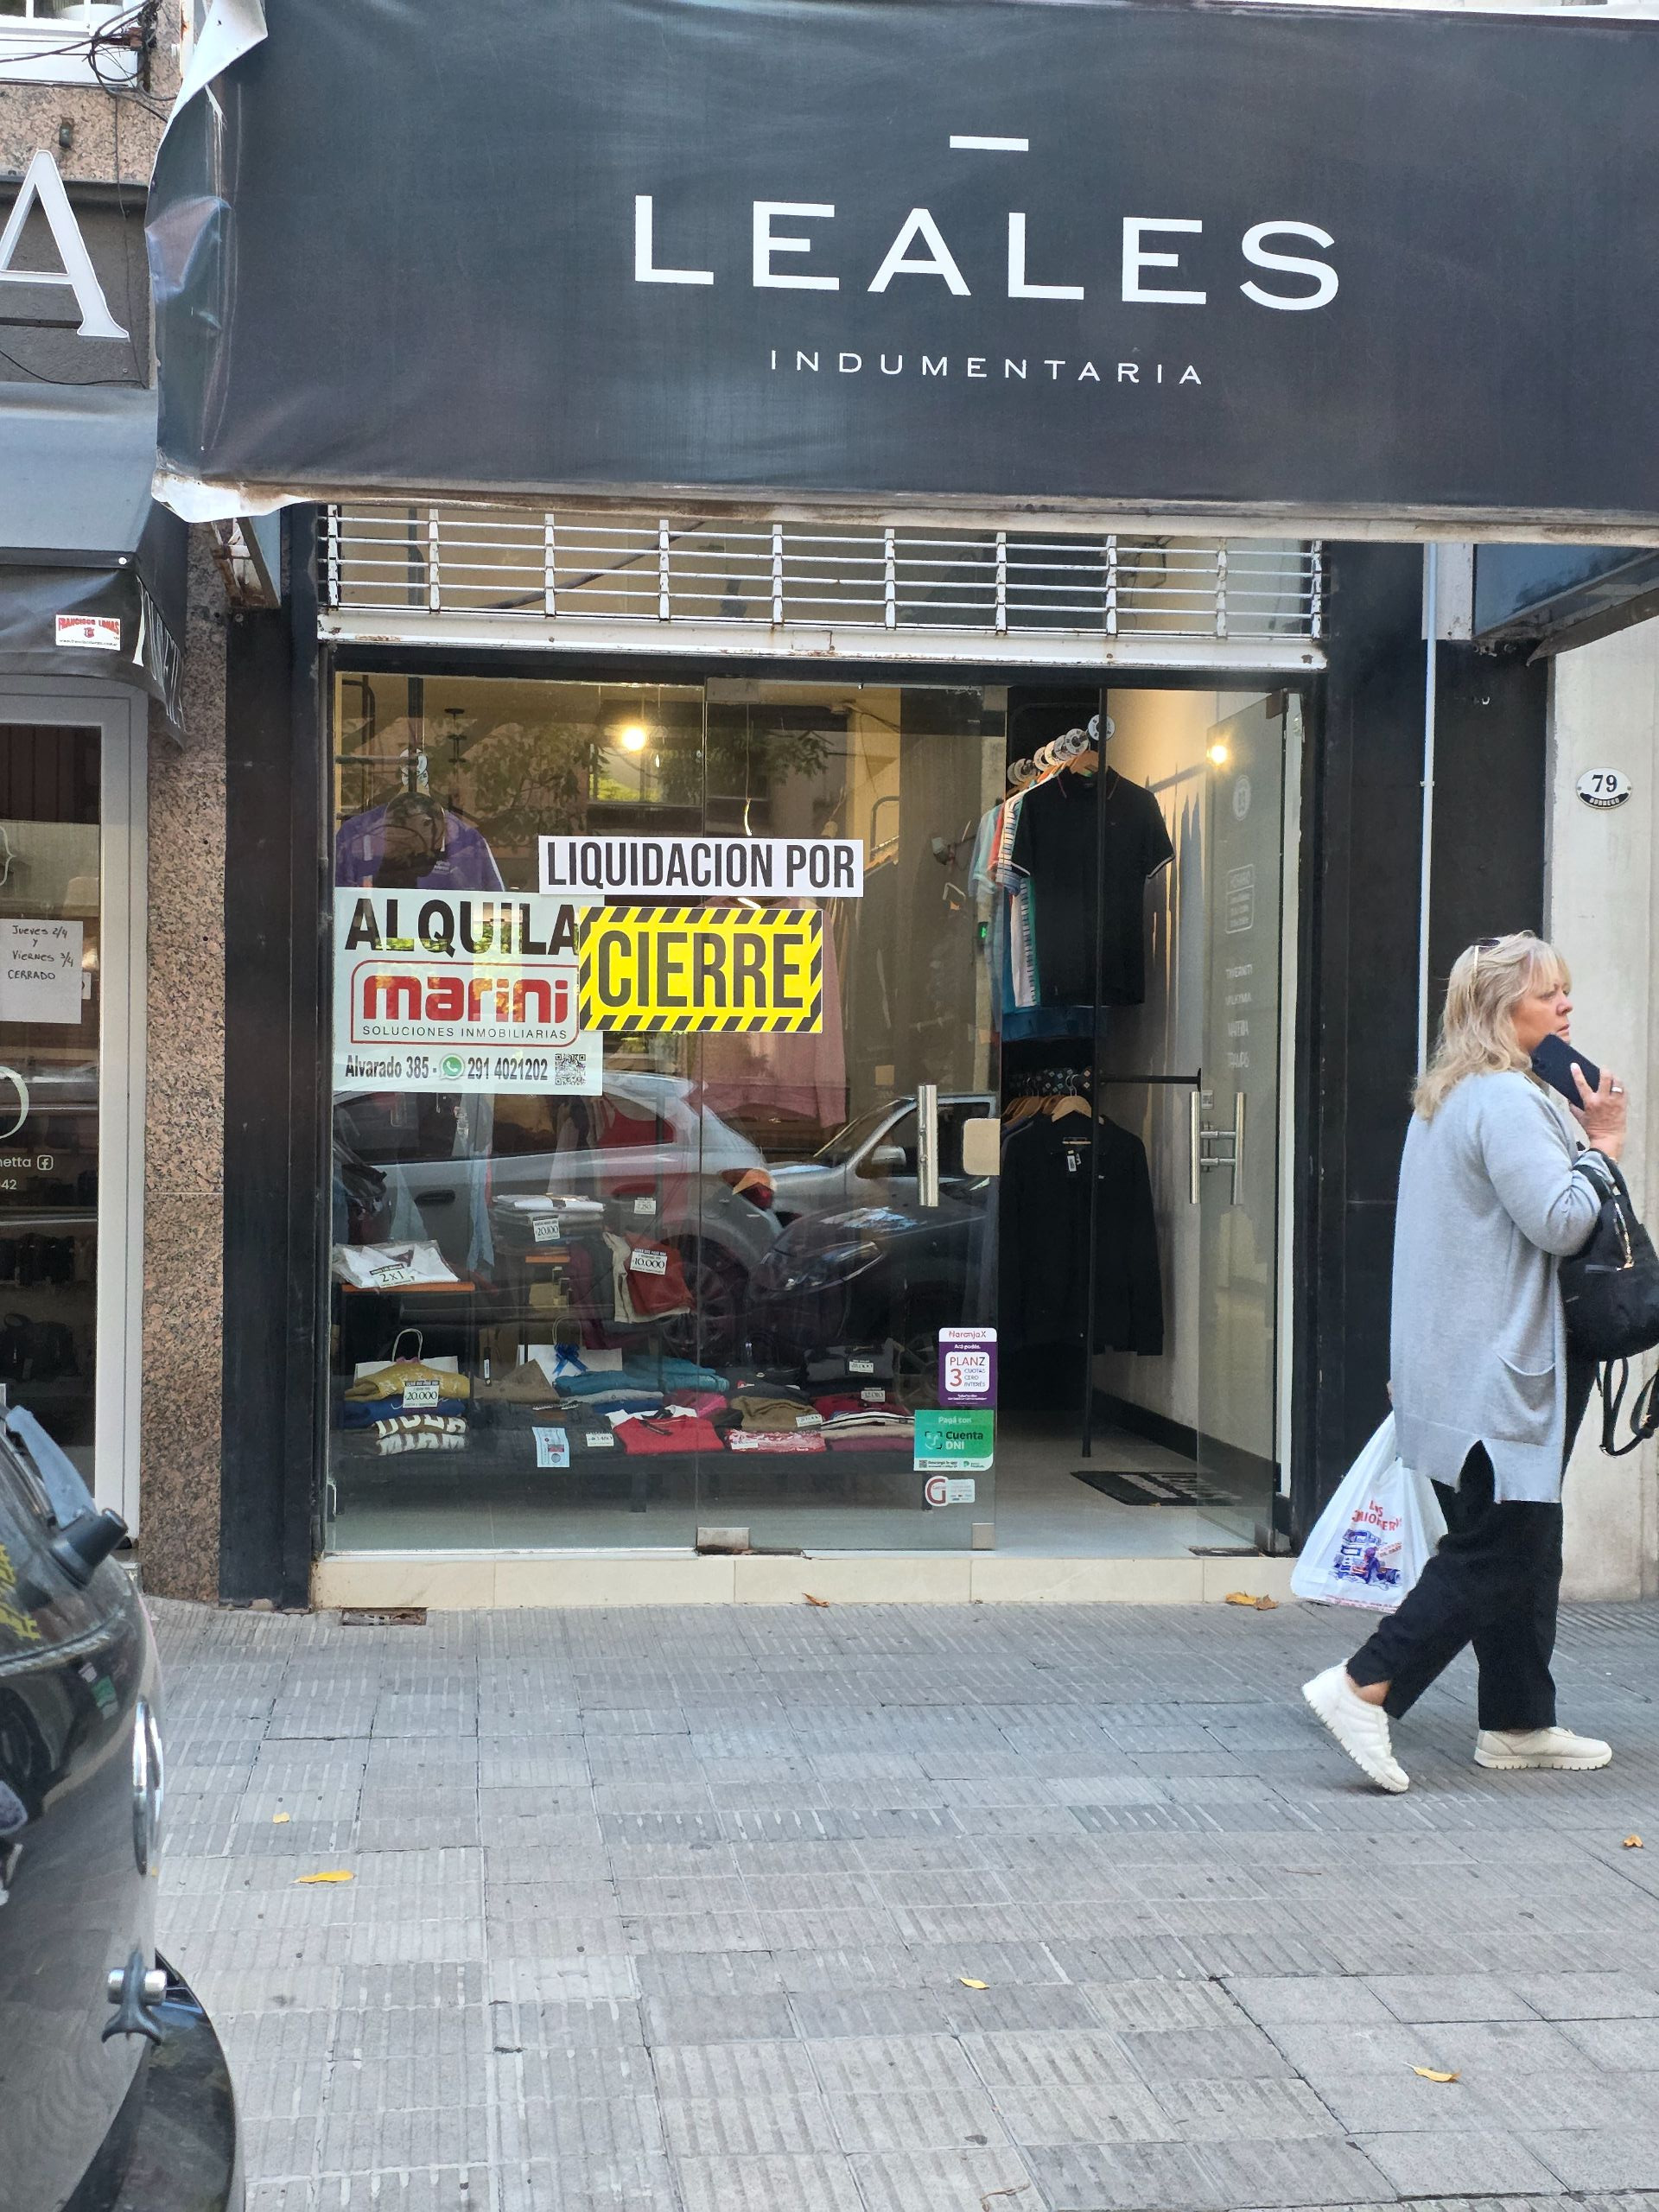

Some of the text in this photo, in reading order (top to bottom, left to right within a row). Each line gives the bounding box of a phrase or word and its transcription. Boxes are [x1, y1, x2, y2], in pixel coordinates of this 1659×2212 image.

[0, 150, 130, 338] A
[634, 194, 1340, 312] LEALES
[770, 349, 1204, 385] INDUMENTARIA
[1592, 774, 1618, 792] 79
[547, 842, 855, 890] LIQUIDACION POR
[52, 926, 68, 940] 2/4
[345, 898, 578, 958] ALQUILA
[60, 951, 73, 968] 3/4
[598, 930, 804, 1008] CIERRE
[8, 969, 55, 981] CERRADO
[363, 975, 569, 1023] marini
[362, 1026, 567, 1039] SOLUCIONES INMOBILIARIAS
[345, 1054, 403, 1077] Alvarado
[406, 1056, 429, 1078] 385
[467, 1057, 489, 1079] 291
[493, 1058, 549, 1080] 4021202
[950, 1368, 963, 1387] 3
[945, 1431, 983, 1440] Cuenta
[945, 1440, 965, 1450] DNI
